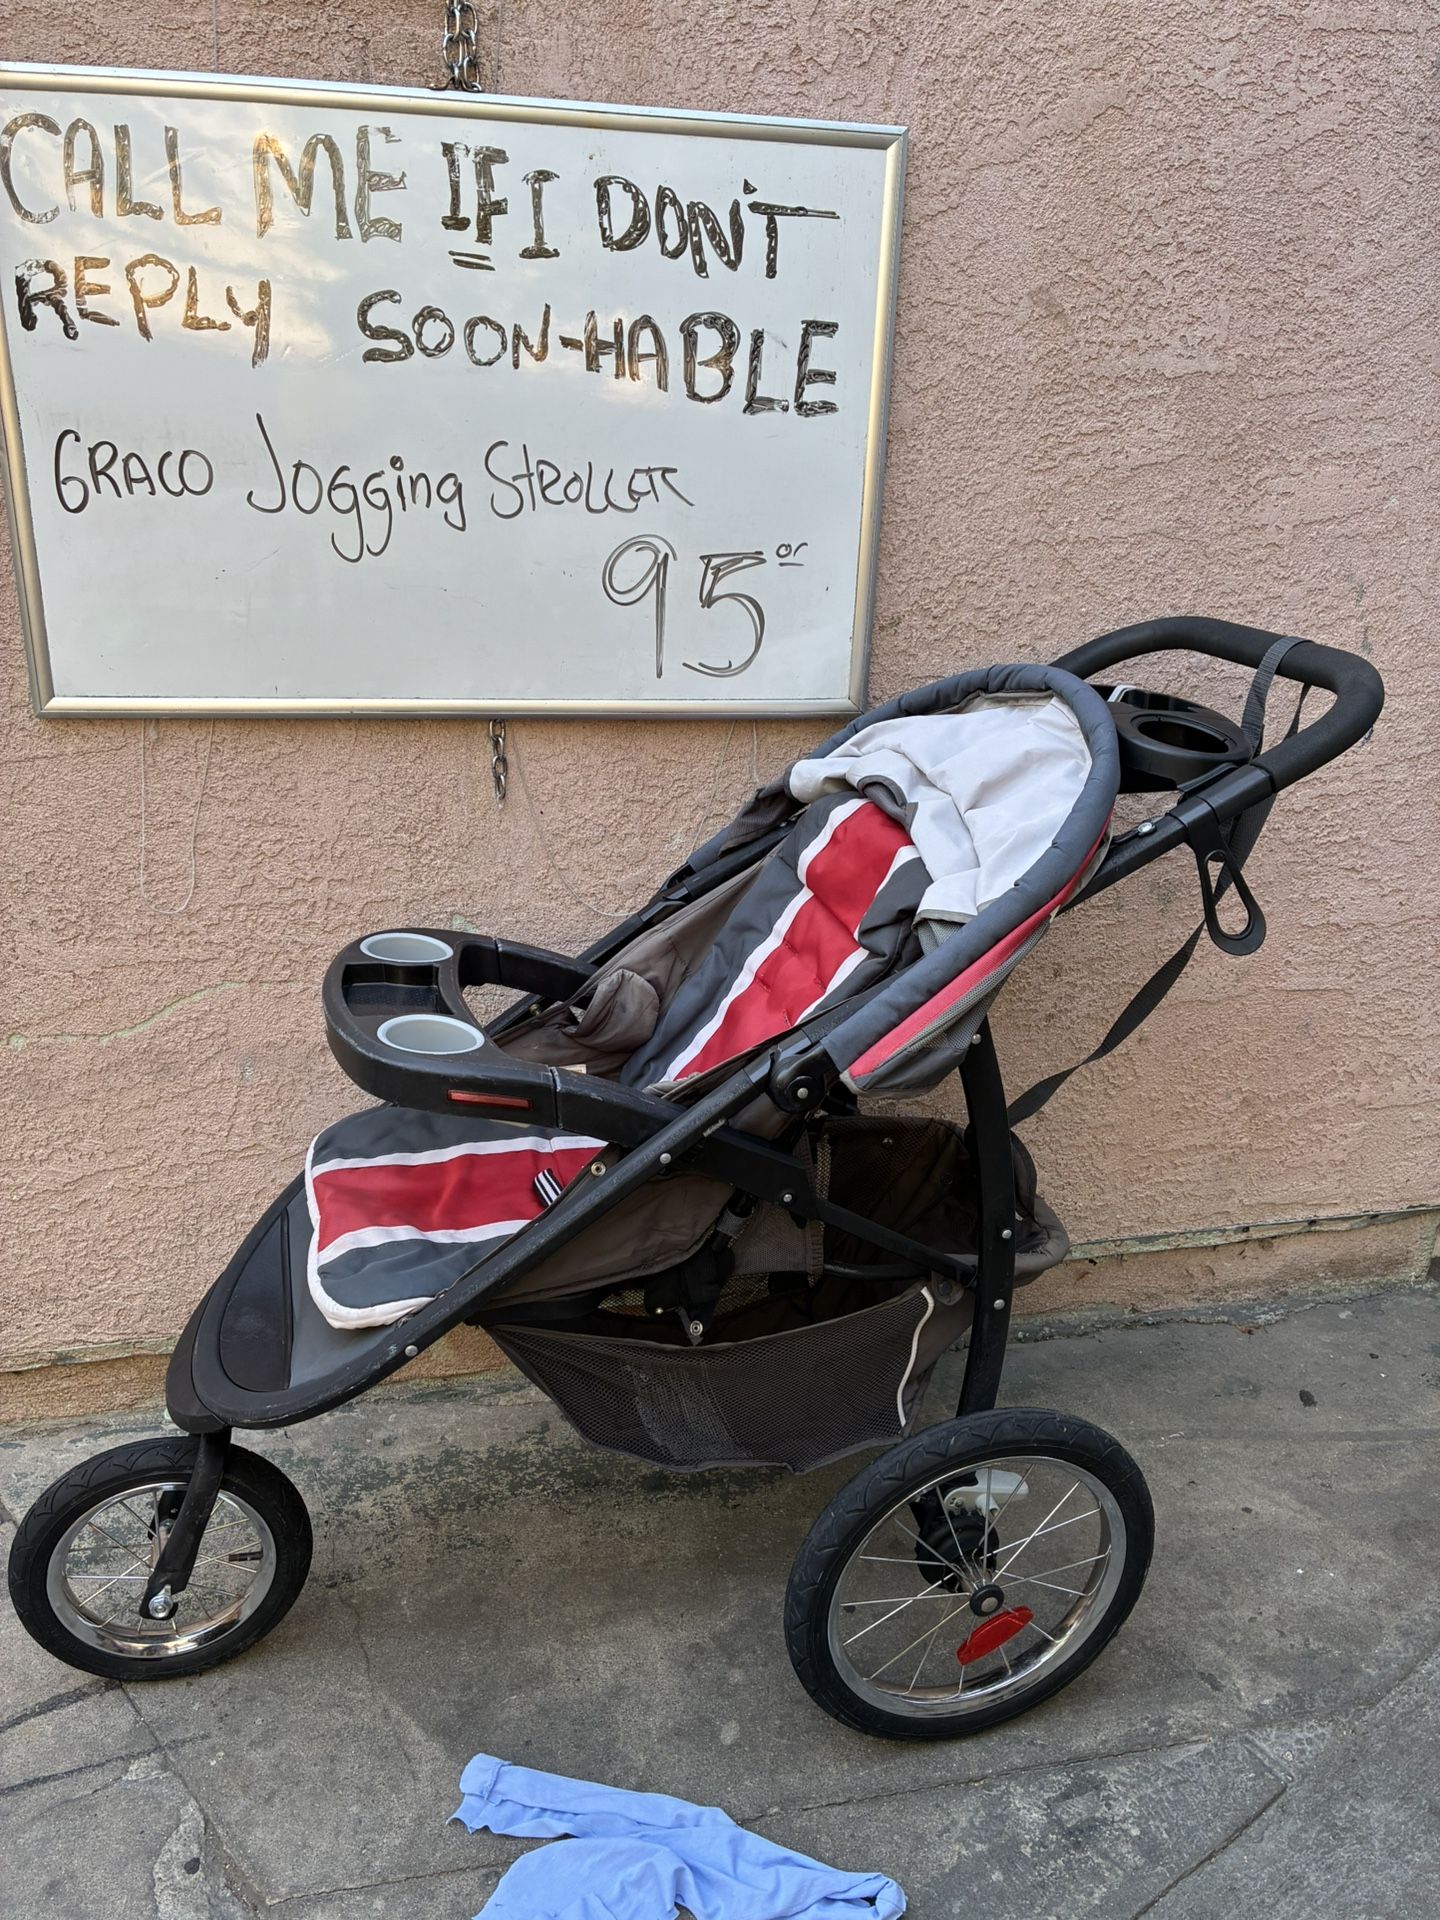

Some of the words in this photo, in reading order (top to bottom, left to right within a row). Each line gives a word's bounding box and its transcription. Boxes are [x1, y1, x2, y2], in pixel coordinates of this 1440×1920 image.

[1, 112, 222, 224] CALL
[252, 125, 407, 243] ME
[440, 141, 509, 246] IF
[518, 169, 561, 259] I
[594, 178, 840, 279] DON'T
[15, 253, 271, 368] REPLY
[54, 428, 213, 514] GRACO
